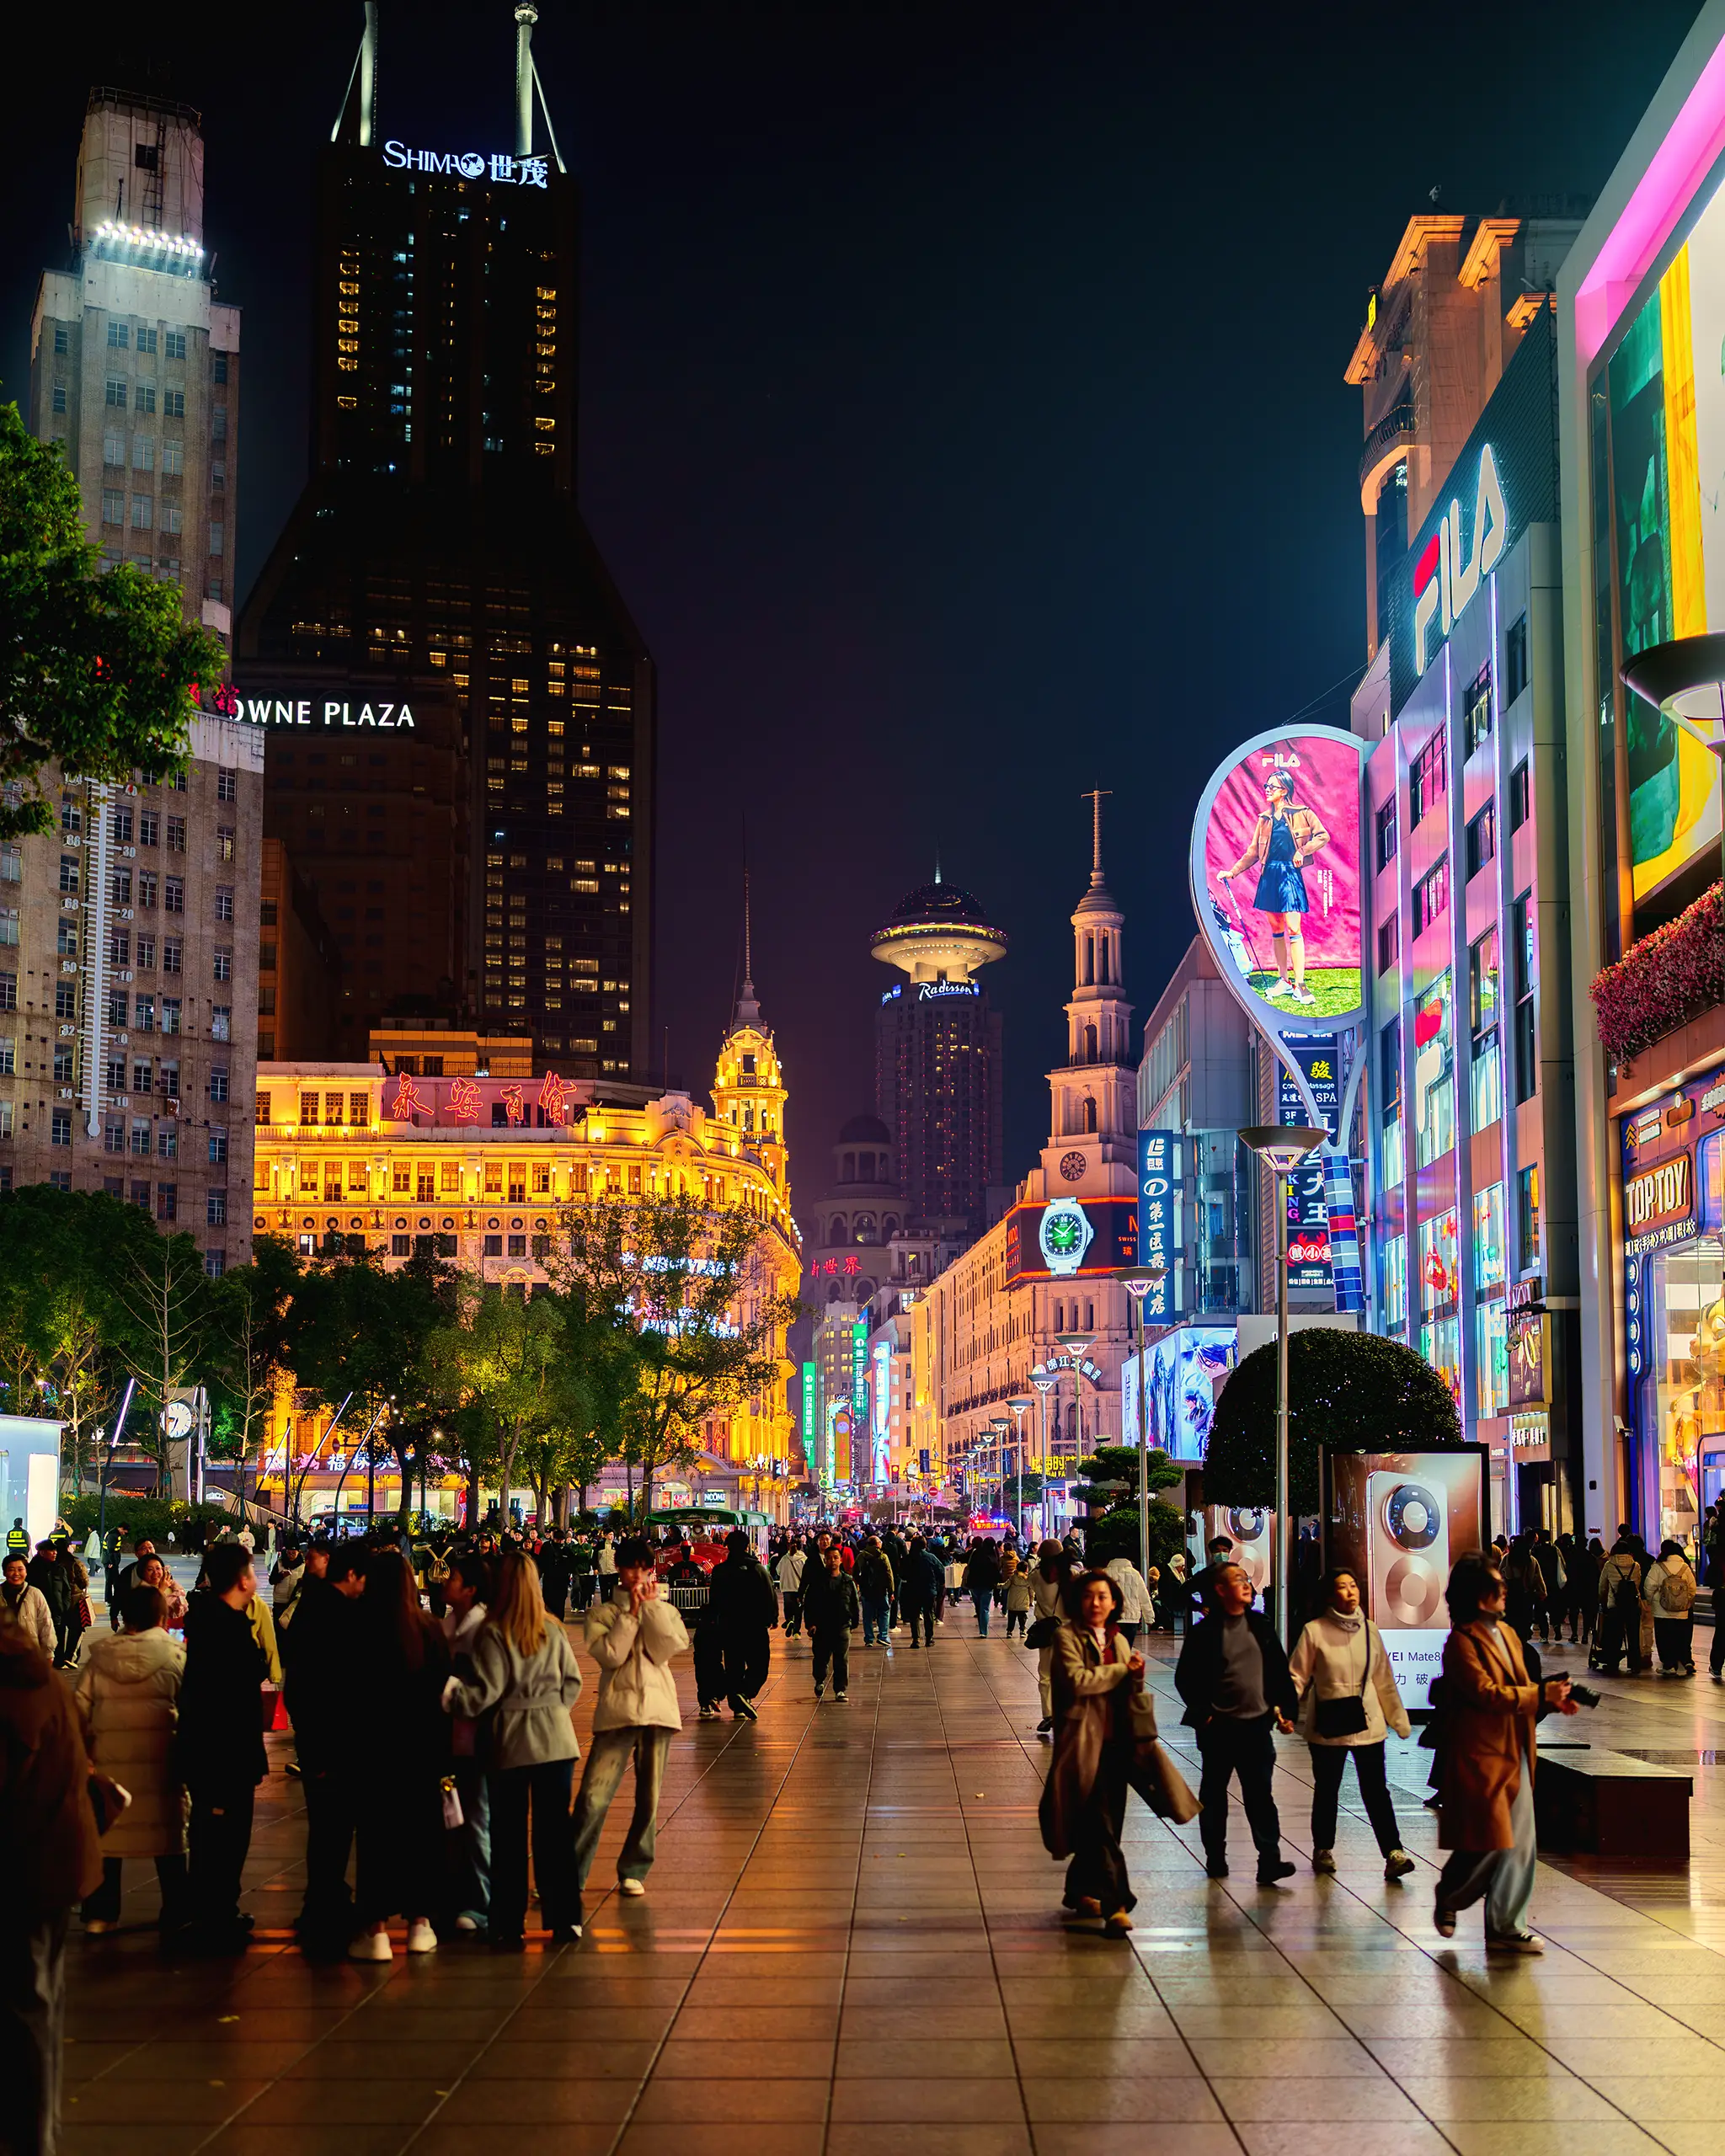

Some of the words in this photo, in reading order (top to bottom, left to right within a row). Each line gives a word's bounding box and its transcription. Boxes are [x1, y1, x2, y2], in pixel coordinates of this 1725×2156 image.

[488, 153, 548, 189] 世茂
[1413, 443, 1506, 676] FILA
[324, 702, 415, 727] PLAZA
[1262, 753, 1301, 767] FILA
[122, 846, 136, 858] 30
[120, 909, 135, 921] 20
[62, 960, 77, 973] 50
[919, 979, 973, 1001] Radisson
[61, 1024, 76, 1037] 32
[61, 1087, 73, 1099] 14
[1316, 1092, 1338, 1102] SPA
[811, 1256, 862, 1280] 新世界
